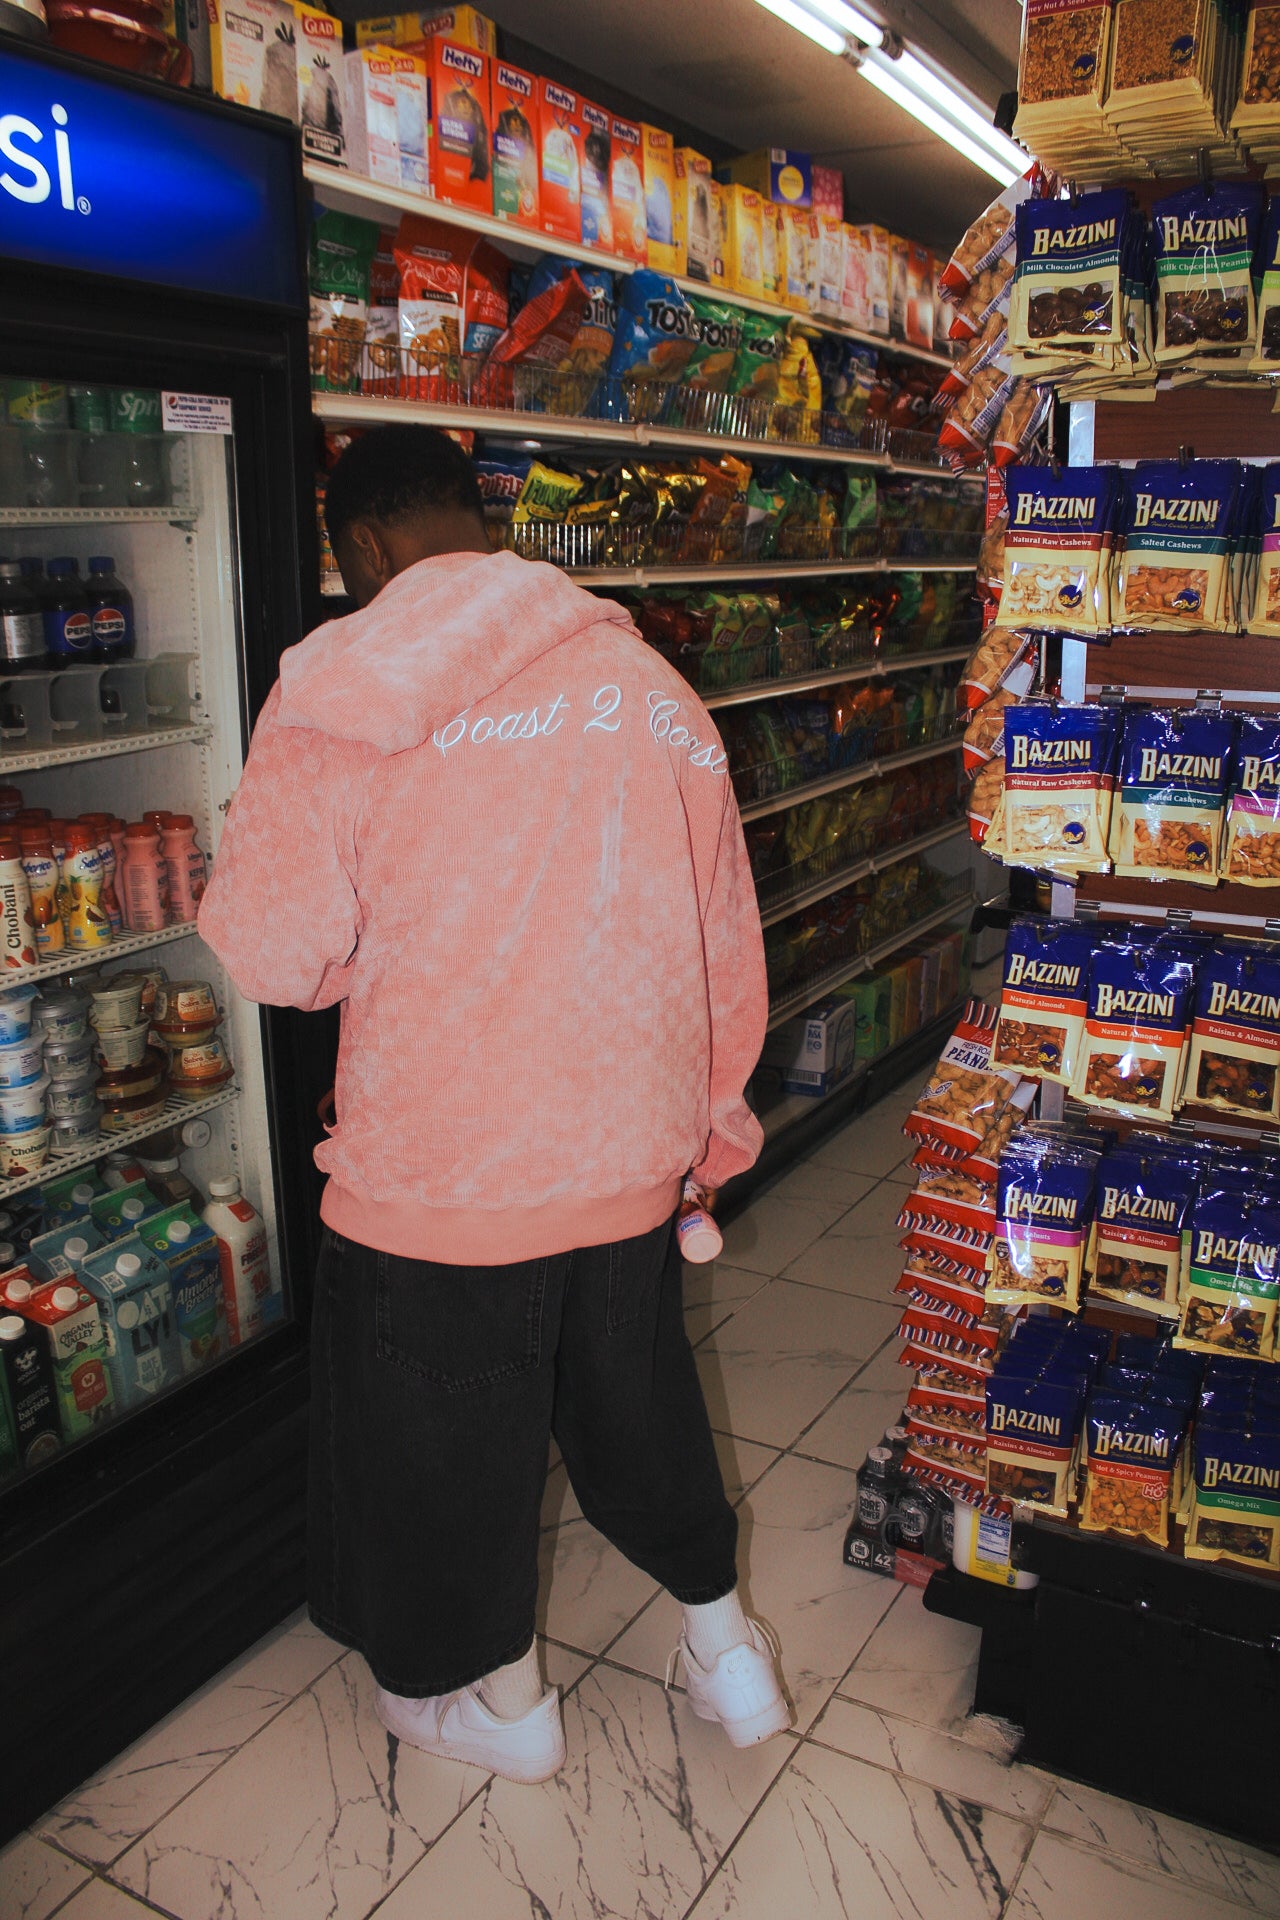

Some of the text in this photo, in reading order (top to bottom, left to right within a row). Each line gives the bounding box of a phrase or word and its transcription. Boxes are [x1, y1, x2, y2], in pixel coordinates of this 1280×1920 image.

[1044, 2, 1057, 11] Nut
[304, 17, 334, 37] GLAD
[444, 49, 480, 76] Hefty
[499, 68, 530, 95] Hefty
[546, 86, 575, 112] Hefty
[584, 106, 608, 131] Hefty
[613, 123, 640, 145] Hefty
[1031, 217, 1116, 256] BAZZINI
[1161, 215, 1248, 252] BAZZINI
[1026, 255, 1119, 272] Milk Chocolate Almonds
[1160, 263, 1177, 273] Milk
[1178, 261, 1218, 272] Chocolate
[1014, 493, 1096, 525] BAZZINI
[1134, 493, 1219, 527] BAZZINI
[1012, 536, 1092, 546] Natural Raw Cashews
[1140, 538, 1202, 549] Salted Cashews
[94, 620, 124, 631] PEPSI
[433, 693, 570, 757] Coast
[584, 685, 622, 733] 2
[1011, 735, 1091, 768] BAZZINI
[1138, 748, 1221, 783] BAZZINI
[1011, 778, 1040, 787] Natural
[1059, 778, 1092, 786] Cashews
[1148, 793, 1207, 805] Salted Cashews
[1246, 802, 1280, 813] Unsalte
[1, 883, 21, 949] Chobani
[1006, 953, 1081, 986] BAZZINI
[1009, 994, 1065, 1010] Natural Almonds
[1095, 983, 1176, 1018] BAZZINI
[962, 1041, 978, 1052] FRESH
[1100, 1027, 1163, 1042] Natural Almonds
[1208, 1025, 1278, 1046] Raisins & Almonds
[946, 1046, 993, 1072] PEANU
[1002, 1186, 1077, 1219] BAZZINI
[1101, 1186, 1176, 1222] BAZZINI
[1023, 1230, 1051, 1241] alnuts
[1102, 1228, 1128, 1239] Raisins
[1136, 1234, 1167, 1247] Almonds
[1194, 1230, 1277, 1269] BAZZINI
[175, 1264, 219, 1308] Almond
[59, 1319, 96, 1345] ORGANIC
[64, 1328, 94, 1349] VALLEY
[16, 1384, 48, 1410] organic
[18, 1396, 50, 1421] barista
[19, 1418, 36, 1432] oat
[991, 1403, 1061, 1437] BAZZINI
[993, 1439, 1018, 1449] Raisins
[1026, 1445, 1056, 1457] Almonds
[1094, 1425, 1169, 1458] BAZZINI
[1095, 1463, 1108, 1473] Hot
[1116, 1467, 1134, 1478] Spicy
[1136, 1471, 1163, 1482] Peanuts
[1202, 1457, 1280, 1489] BAZZINI
[1217, 1497, 1261, 1509] Omega Mix
[848, 1555, 870, 1567] ELITE
[875, 1553, 891, 1567] 42
